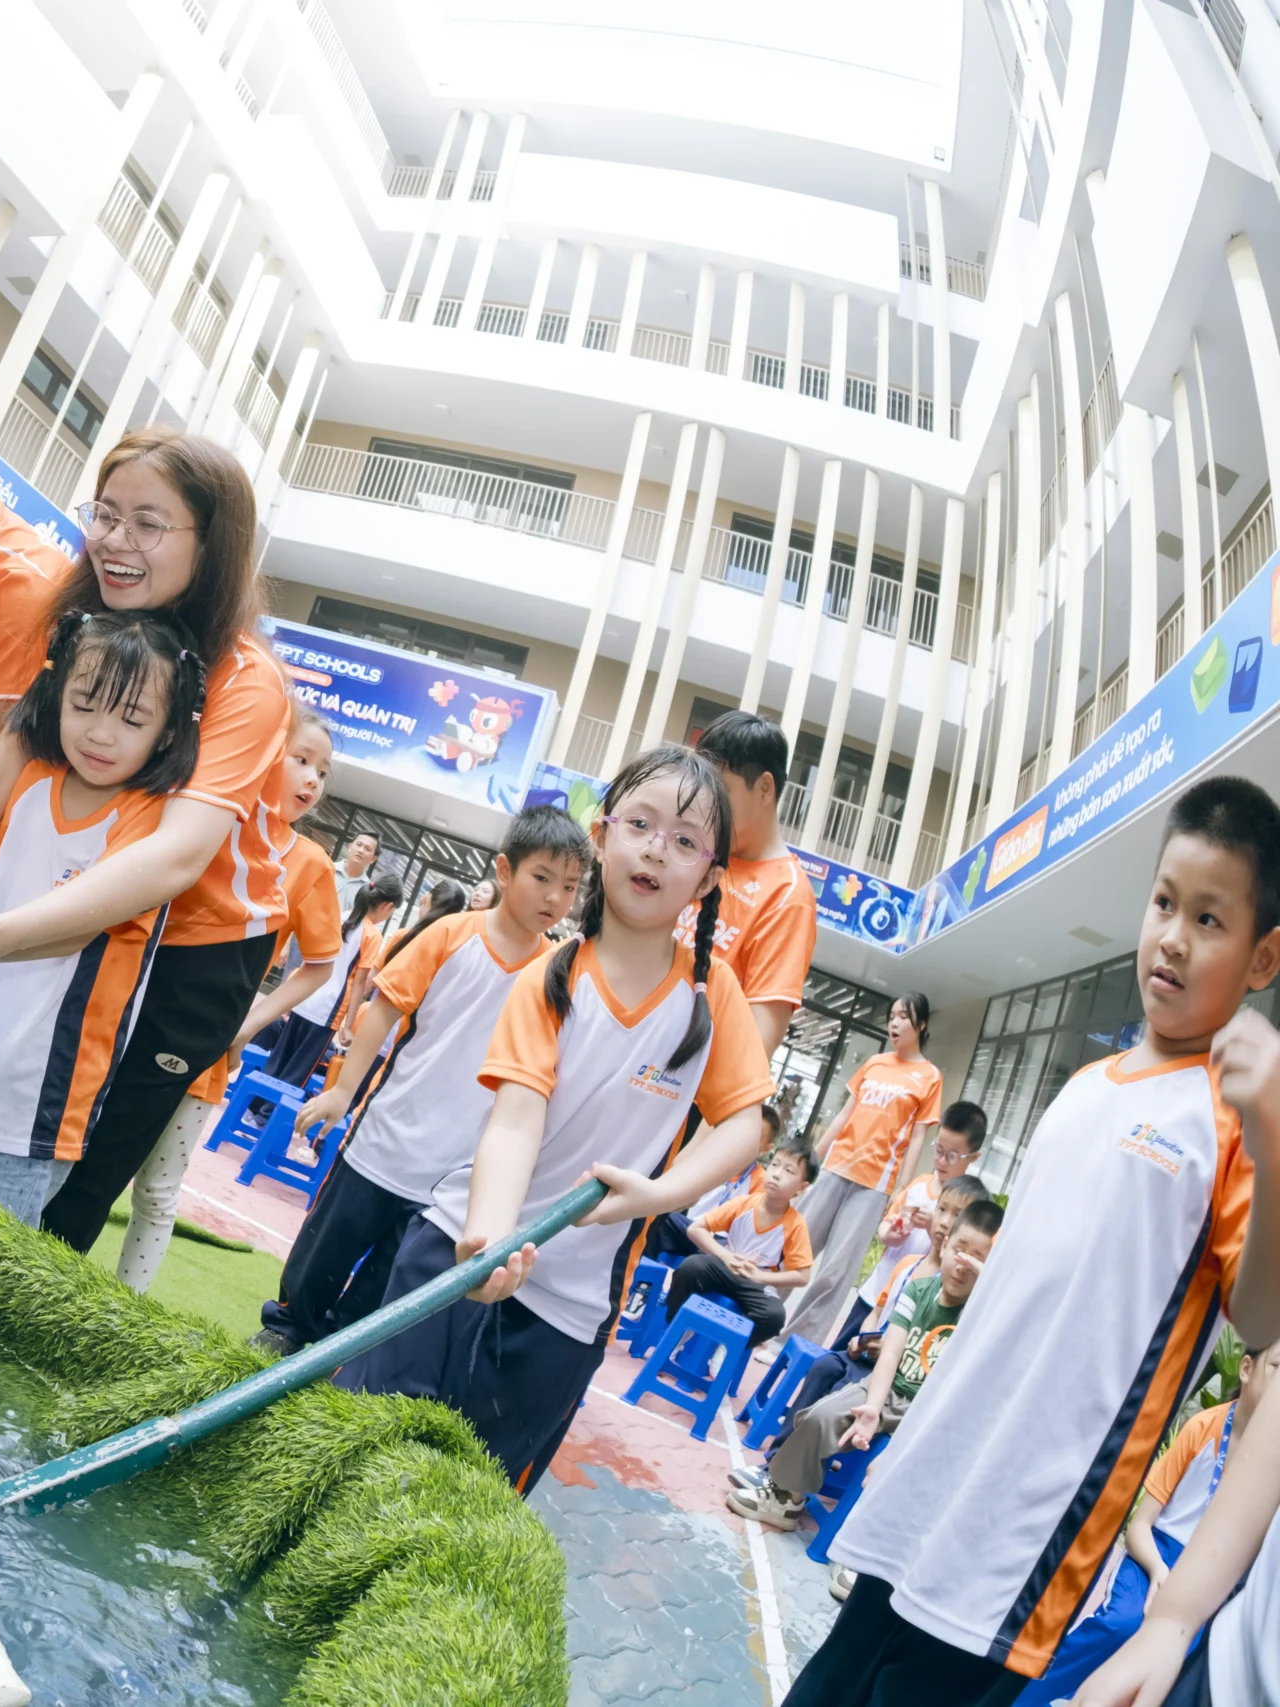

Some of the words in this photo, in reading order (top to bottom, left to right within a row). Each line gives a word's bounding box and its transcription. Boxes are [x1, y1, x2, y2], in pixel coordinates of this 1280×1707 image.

[273, 643, 305, 661] FPT
[304, 652, 382, 683] SCHOOLS
[287, 684, 321, 706] HỨC
[341, 700, 392, 727] QUẢN
[391, 713, 418, 737] TRỊ
[339, 724, 373, 743] người
[372, 733, 394, 749] học
[1054, 776, 1085, 814] không
[1083, 750, 1109, 794] phải
[1109, 731, 1126, 769] để
[1125, 723, 1146, 756] tạo
[1146, 707, 1162, 738] ra
[1047, 811, 1080, 850] những
[1078, 796, 1101, 829] bản
[1100, 781, 1122, 812] sao
[1121, 750, 1152, 797] xuất
